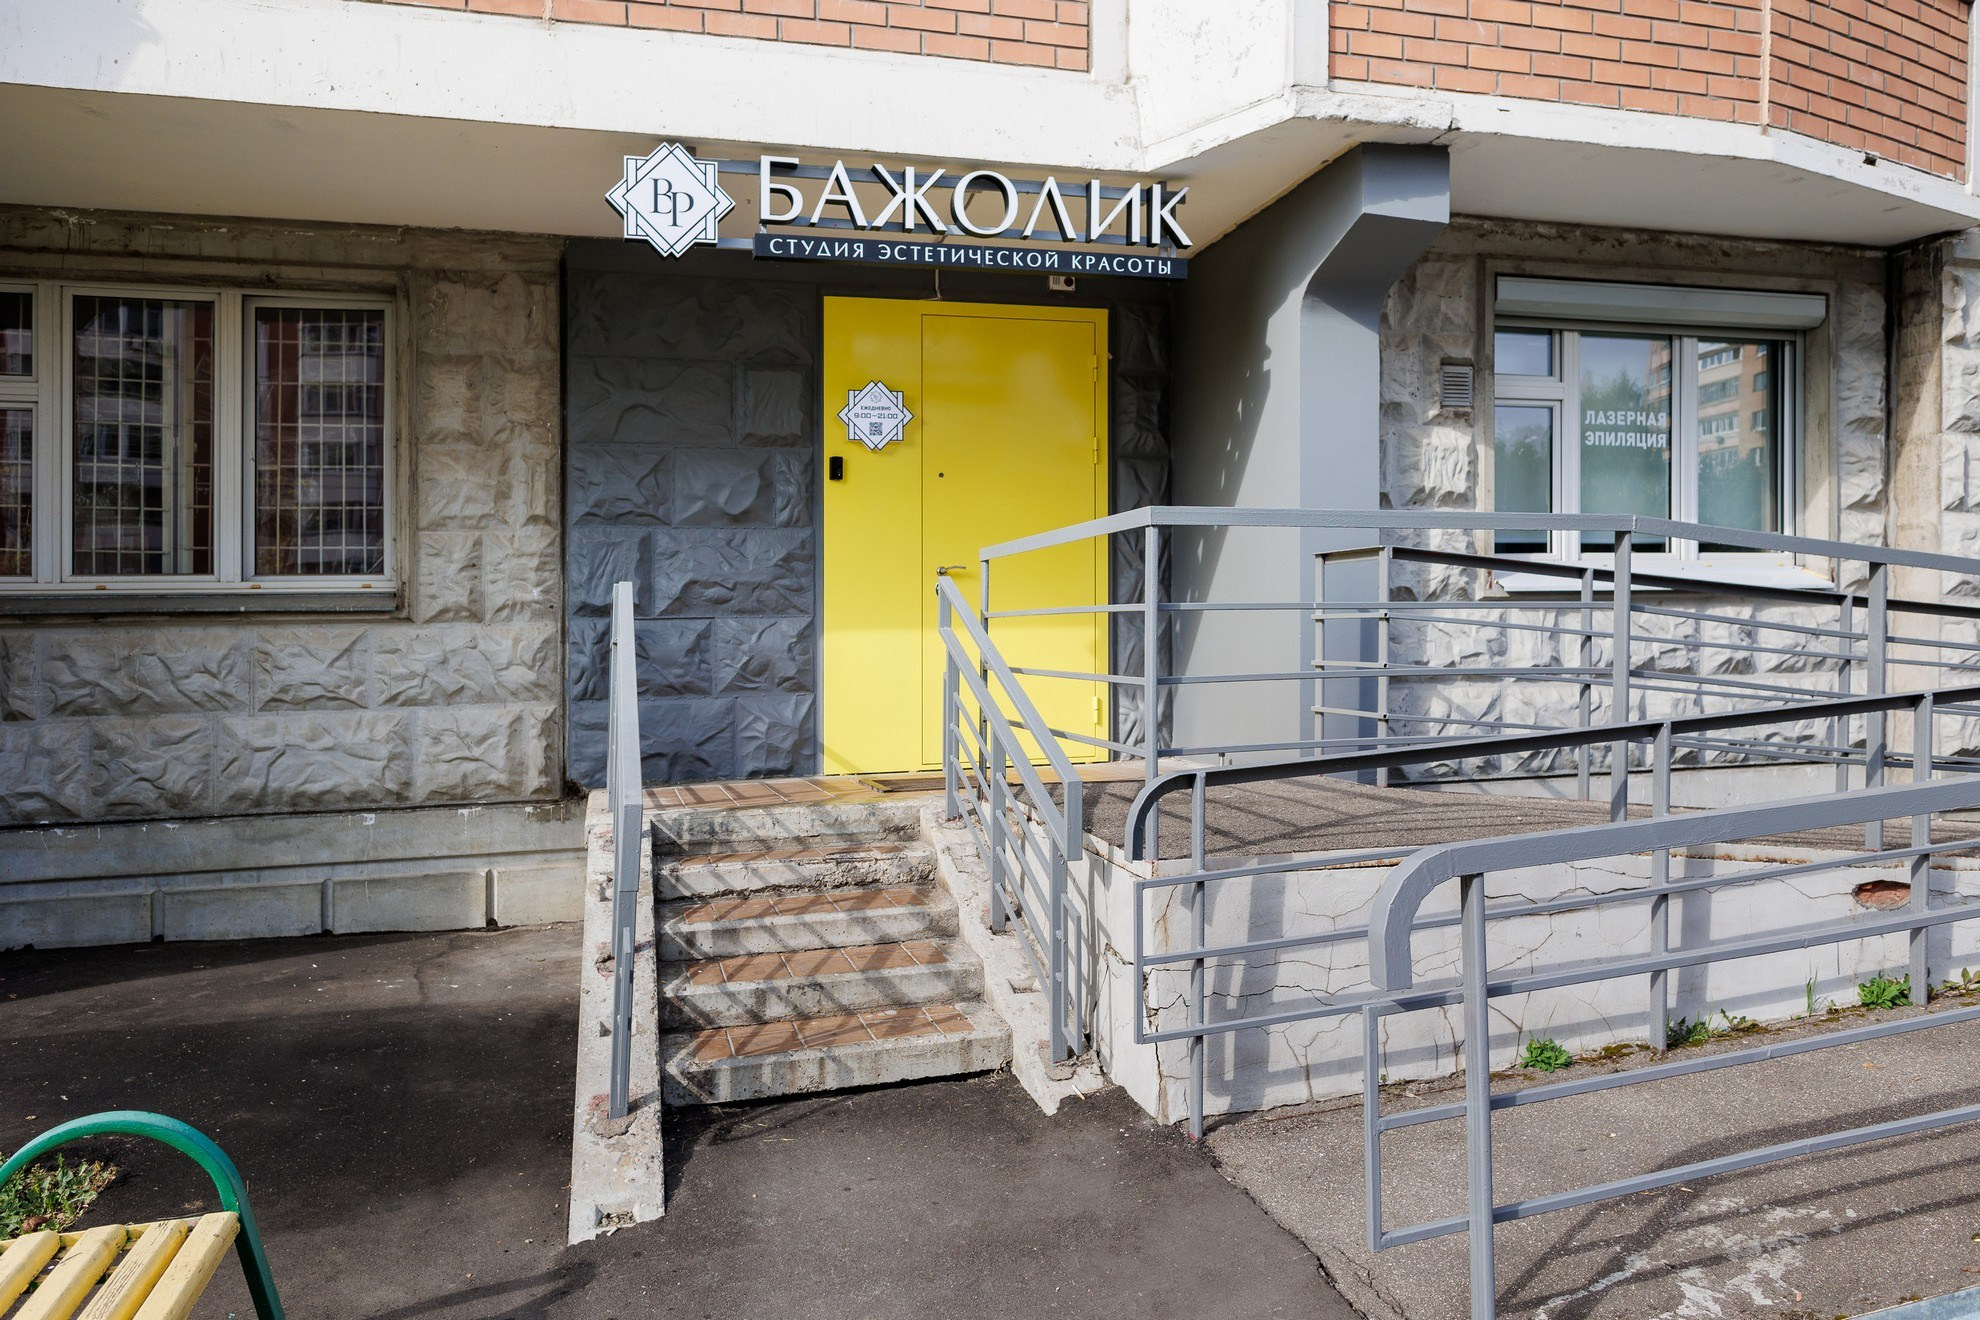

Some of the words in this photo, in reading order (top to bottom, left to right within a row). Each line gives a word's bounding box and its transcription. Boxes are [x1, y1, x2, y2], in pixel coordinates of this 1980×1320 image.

[759, 155, 1194, 249] БАЖОЛИК
[769, 238, 864, 259] СТУДИЯ
[878, 243, 1059, 269] ЭСТЕТИЧЕСКОЙ
[1071, 255, 1172, 275] КРАСОТЫ
[1584, 410, 1667, 426] ЛАЗЕРНАЯ
[1584, 431, 1667, 450] ЭПИЛЯЦИЯ
